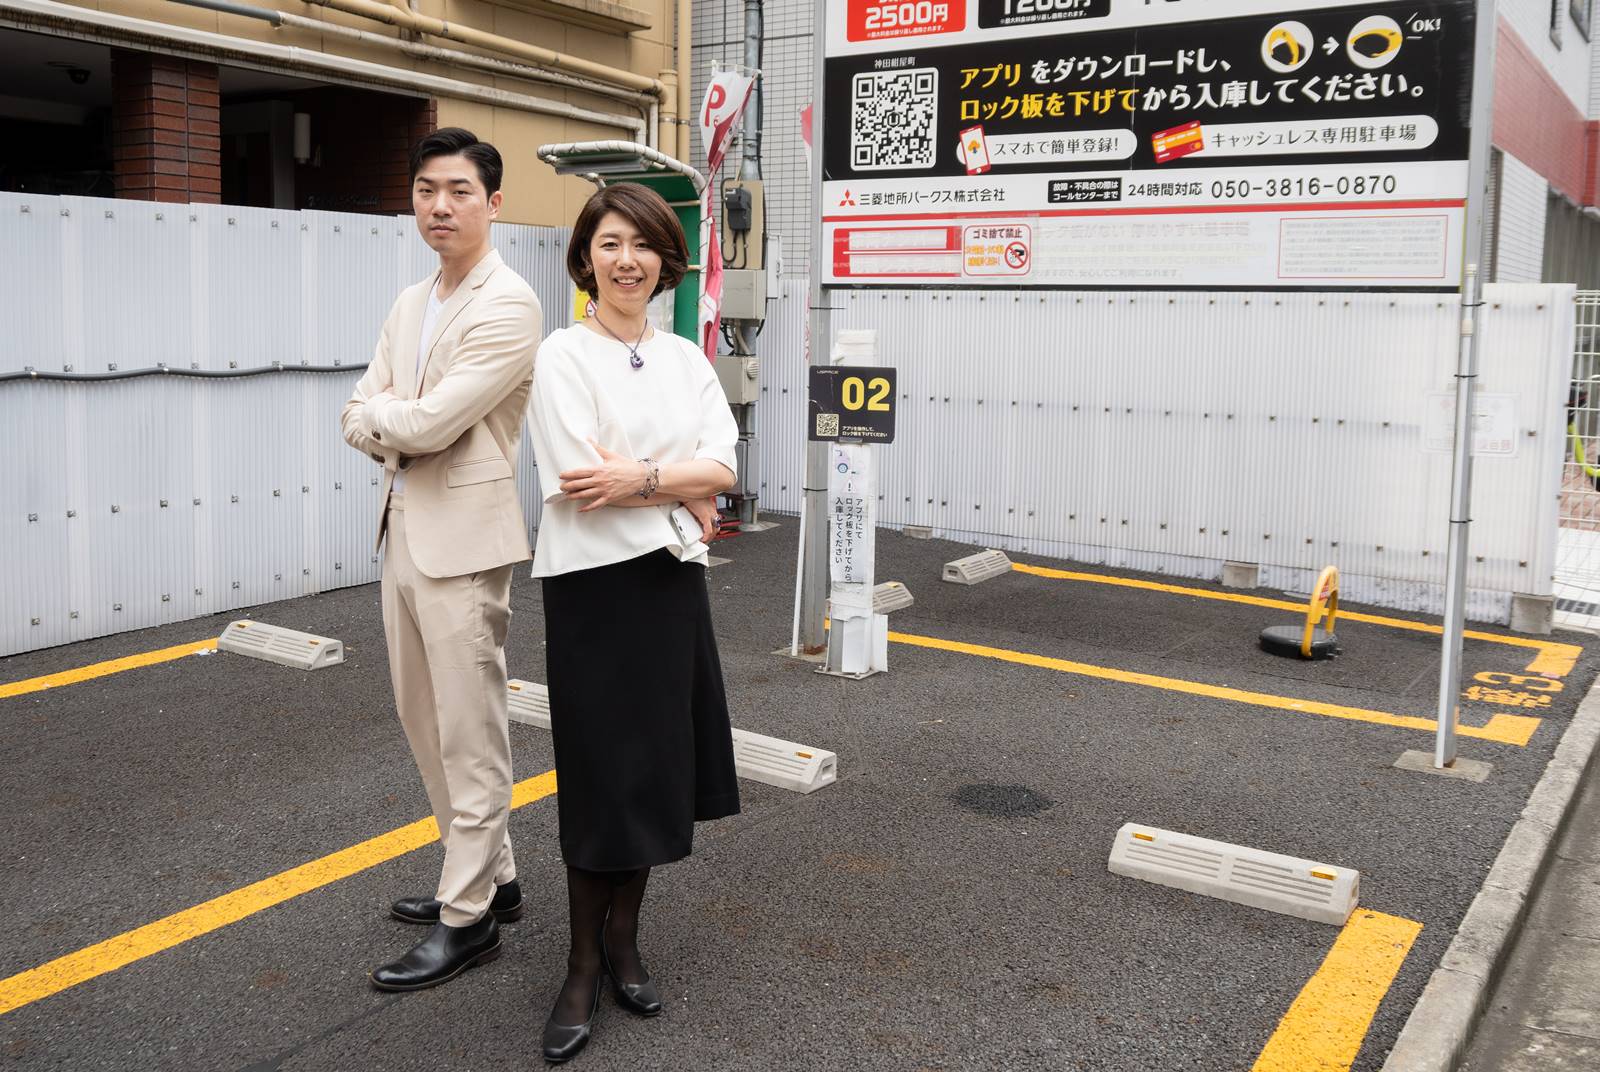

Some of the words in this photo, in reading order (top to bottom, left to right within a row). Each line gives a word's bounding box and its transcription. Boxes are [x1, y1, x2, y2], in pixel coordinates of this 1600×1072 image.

[865, 1, 948, 29] 2500円
[1412, 18, 1441, 32] OK!
[960, 63, 1022, 89] アプリ
[1211, 124, 1417, 148] キャッシュレス専用駐車場
[859, 188, 1006, 206] 三菱地所パークス株式会社
[1053, 190, 1118, 201] コールセンターまで
[1128, 182, 1203, 197] 24時間対応
[1211, 175, 1397, 199] 050-3816-0870
[973, 228, 1023, 239] ゴミ捨て禁止
[842, 376, 891, 411] 02
[835, 496, 844, 564] 入庫してください
[855, 498, 863, 539] アプリにて
[845, 497, 854, 581] ロック板を下げてから
